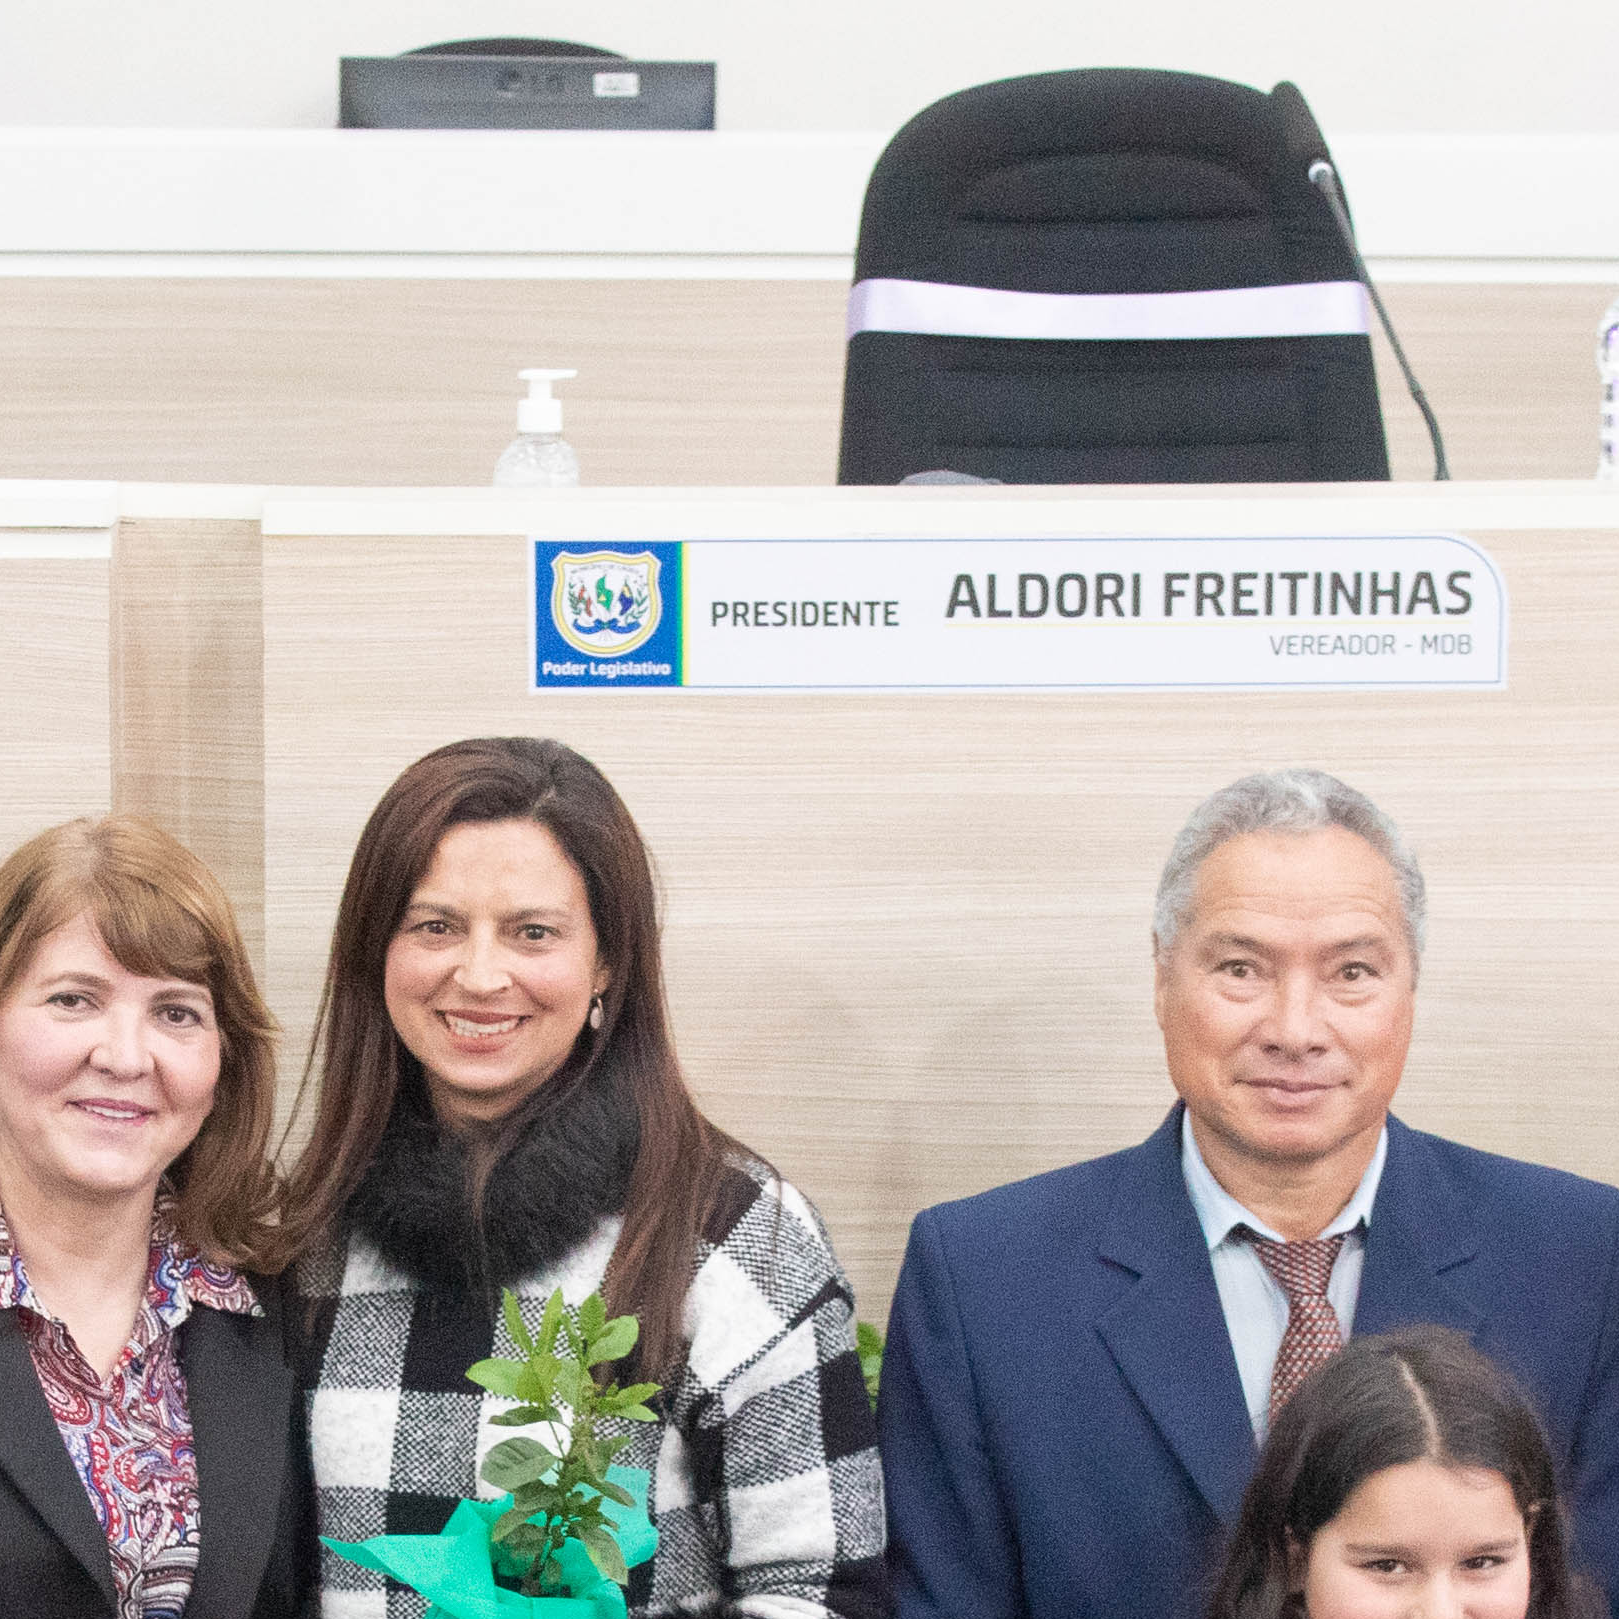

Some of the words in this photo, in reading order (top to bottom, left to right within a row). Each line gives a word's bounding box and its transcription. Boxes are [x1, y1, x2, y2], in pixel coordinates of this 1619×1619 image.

[944, 572, 1141, 619] ALDORI
[1164, 571, 1473, 617] FREITINHAS
[711, 600, 900, 627] PRESIDENTE
[1269, 634, 1395, 656] VEREADOR
[1420, 634, 1473, 655] MDB
[542, 661, 587, 676] Poder
[589, 661, 672, 679] Legislativo
